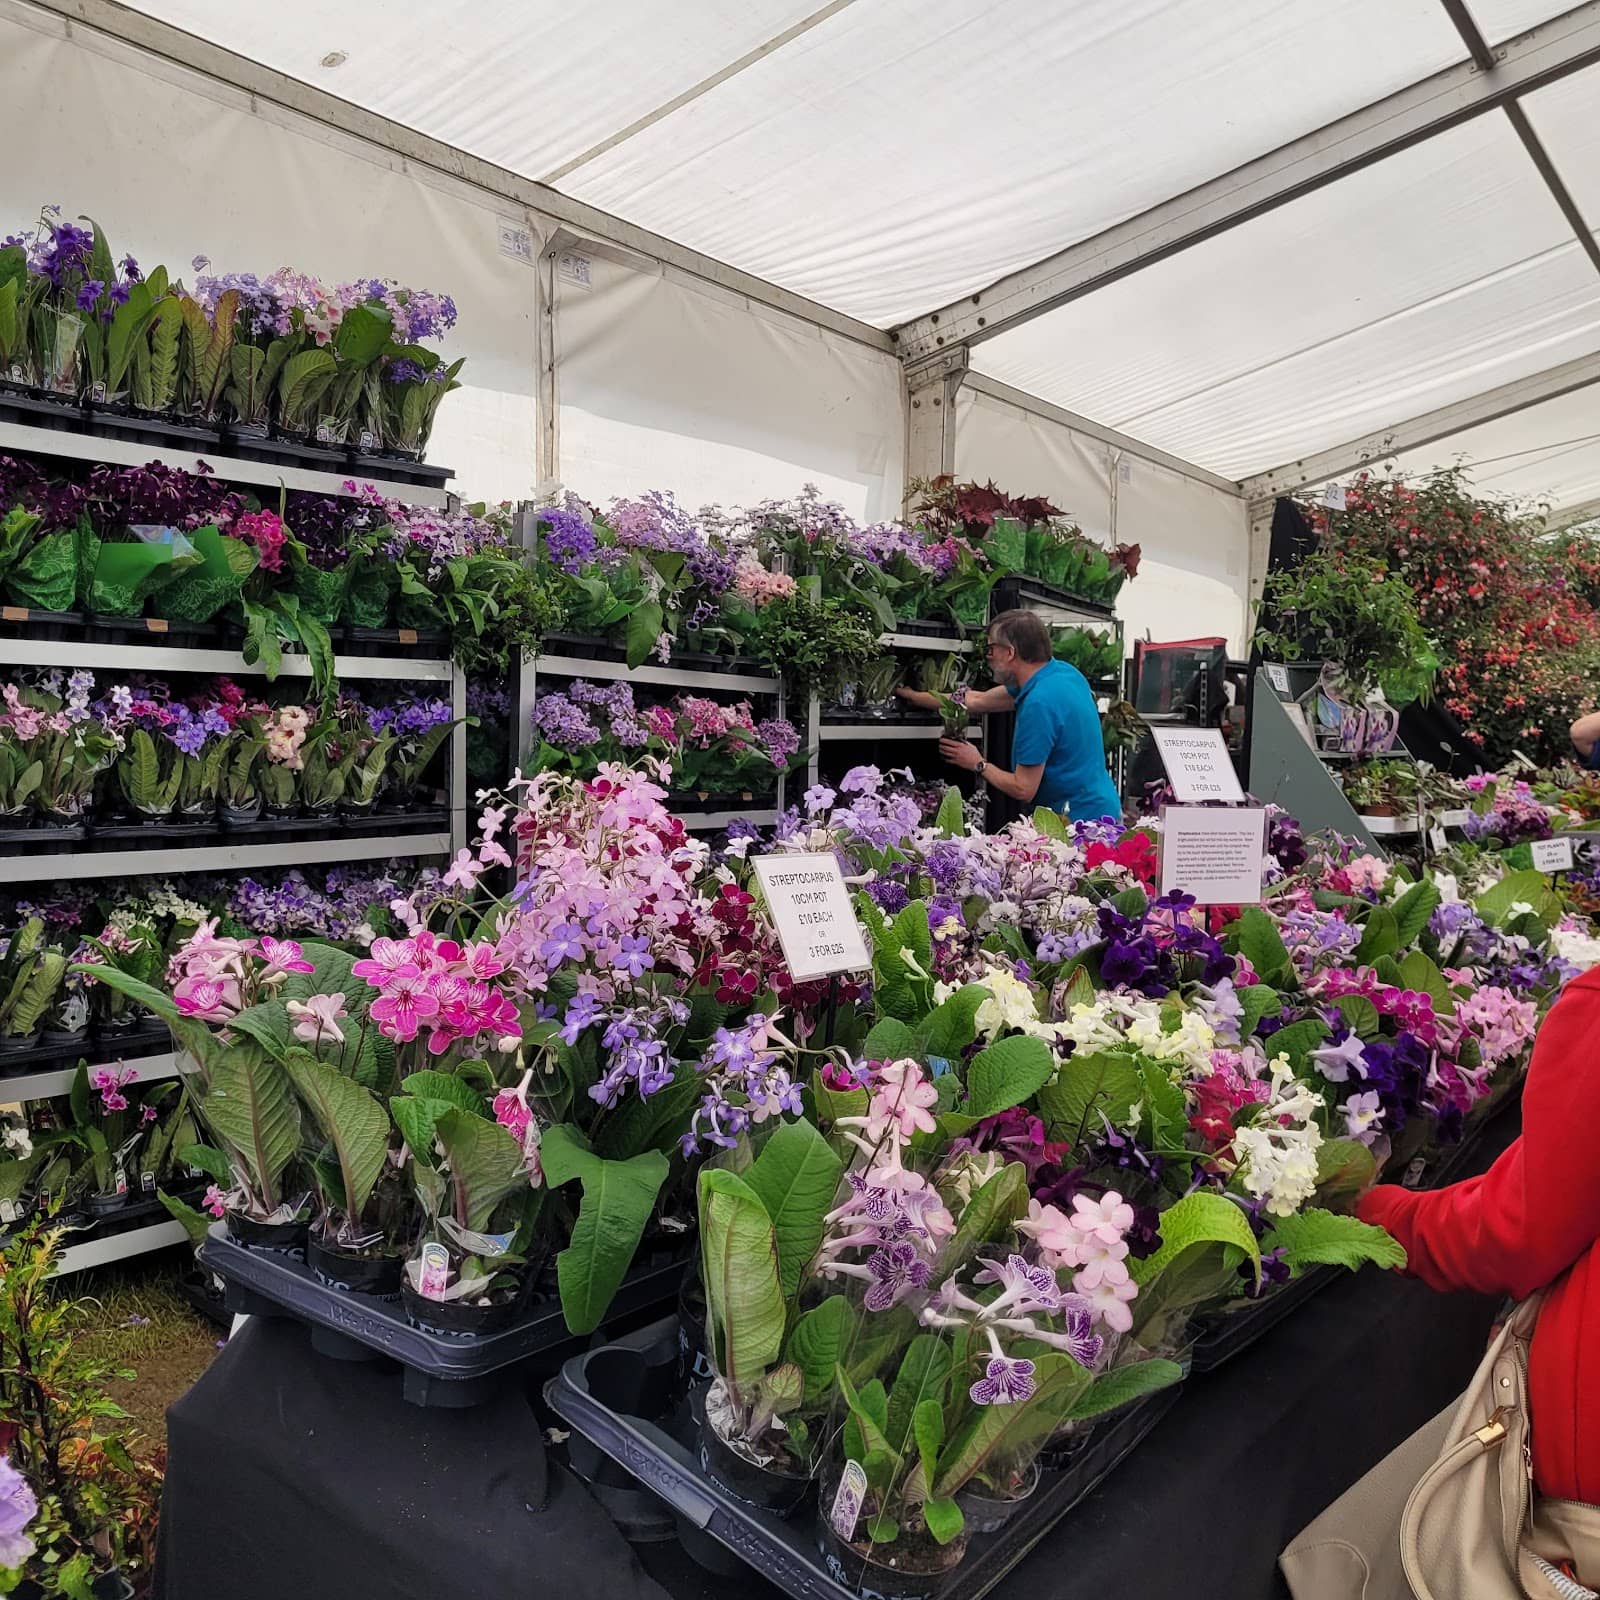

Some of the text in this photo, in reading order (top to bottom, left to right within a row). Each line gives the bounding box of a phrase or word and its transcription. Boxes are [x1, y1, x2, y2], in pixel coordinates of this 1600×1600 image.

[1163, 739, 1217, 748] STREPTOCARPUS
[1179, 752, 1210, 760] 10CM POT
[1196, 764, 1215, 772] EACH
[768, 871, 834, 887] STREPTOCARPUS
[791, 891, 828, 905] 10CM POT
[798, 911, 834, 925] £10 EACH
[818, 930, 826, 938] OR
[809, 943, 845, 958] 3 FOR £25
